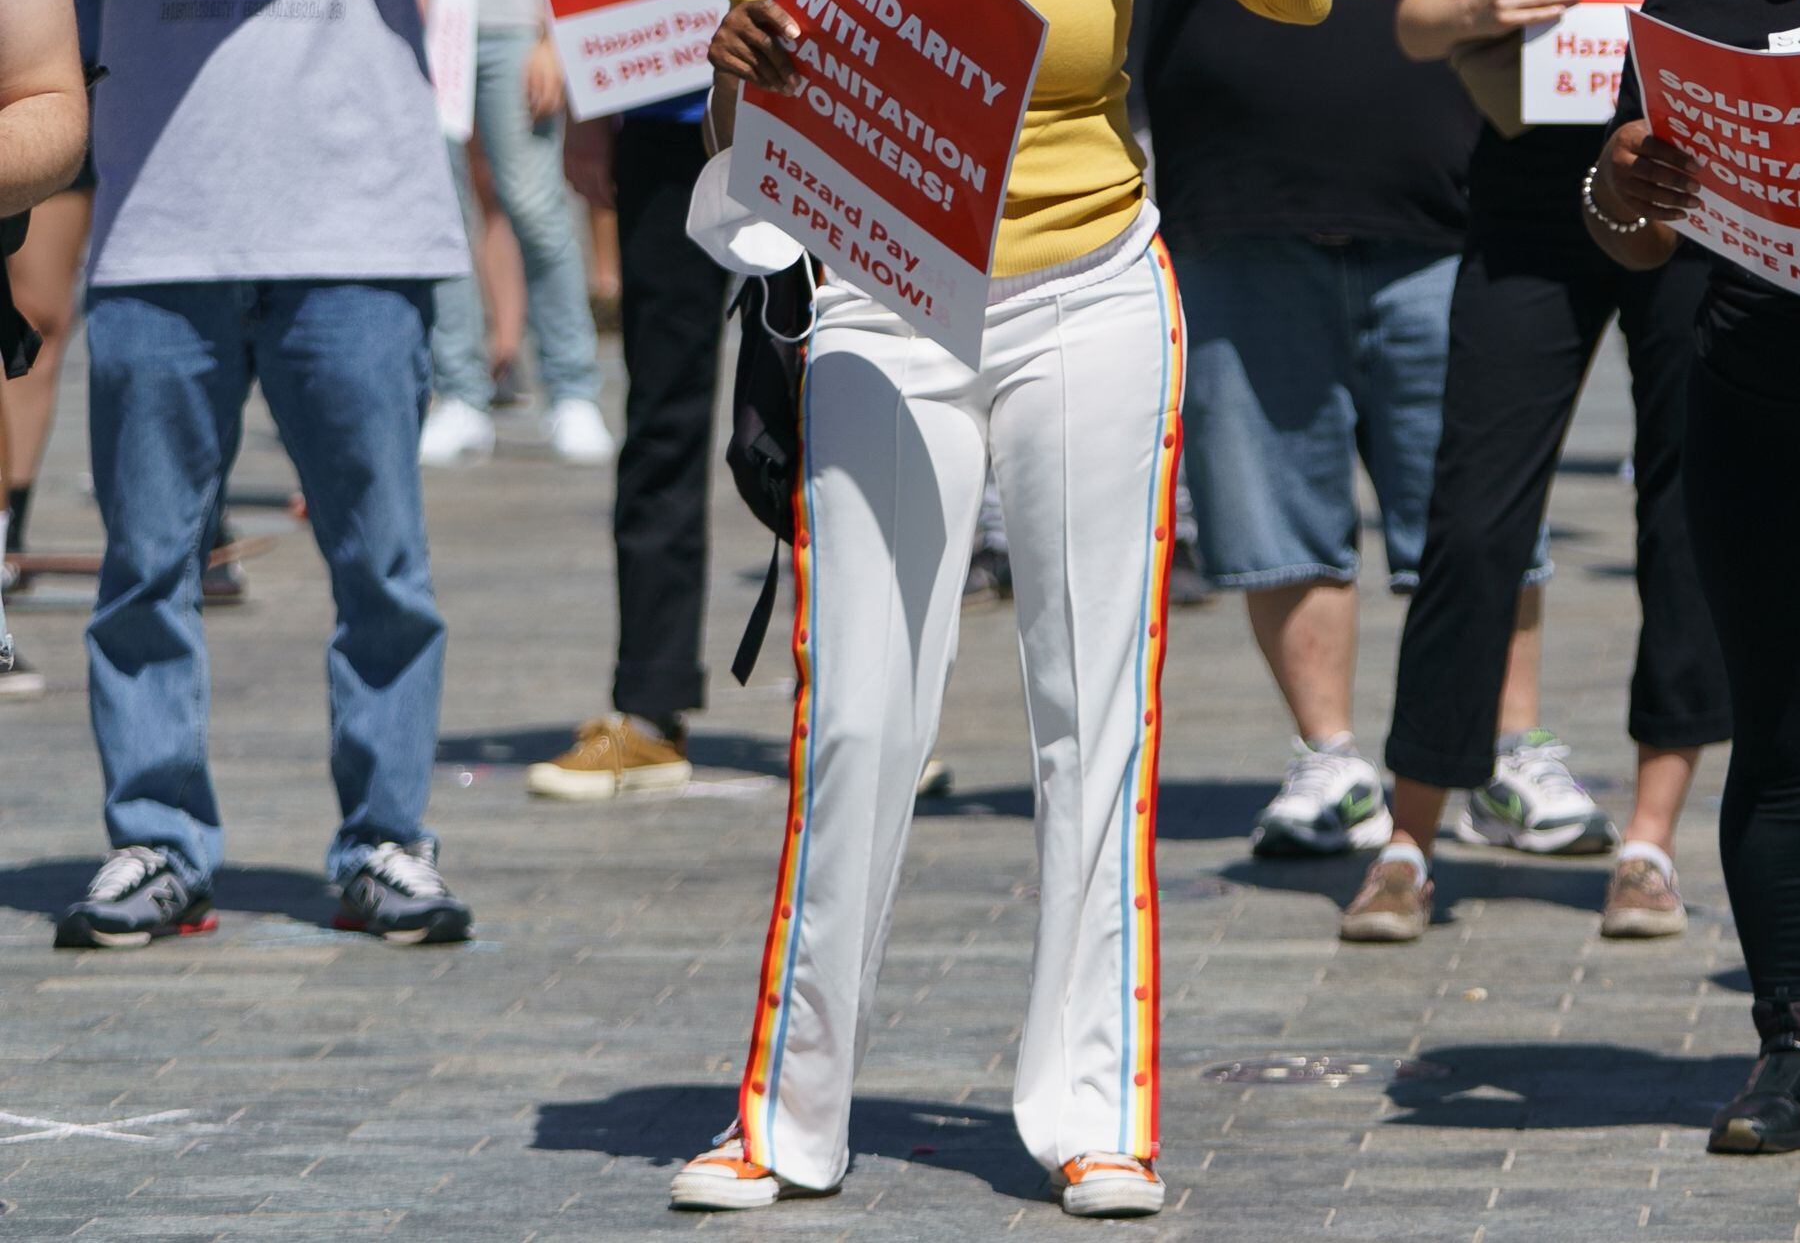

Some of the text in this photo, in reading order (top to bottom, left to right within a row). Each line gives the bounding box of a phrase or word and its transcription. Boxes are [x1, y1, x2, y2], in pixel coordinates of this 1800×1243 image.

[619, 52, 665, 82] PPE
[671, 40, 710, 68] NO
[1555, 33, 1629, 56] Haza
[1555, 70, 1577, 94] &
[1661, 90, 1771, 150] WITH
[763, 138, 920, 274] Hazard Pay
[1699, 201, 1794, 256] azard
[758, 174, 783, 208] &
[792, 193, 843, 250] PPE
[848, 240, 934, 318] NOW!
[1687, 212, 1710, 236] &
[1721, 231, 1780, 273] PPE
